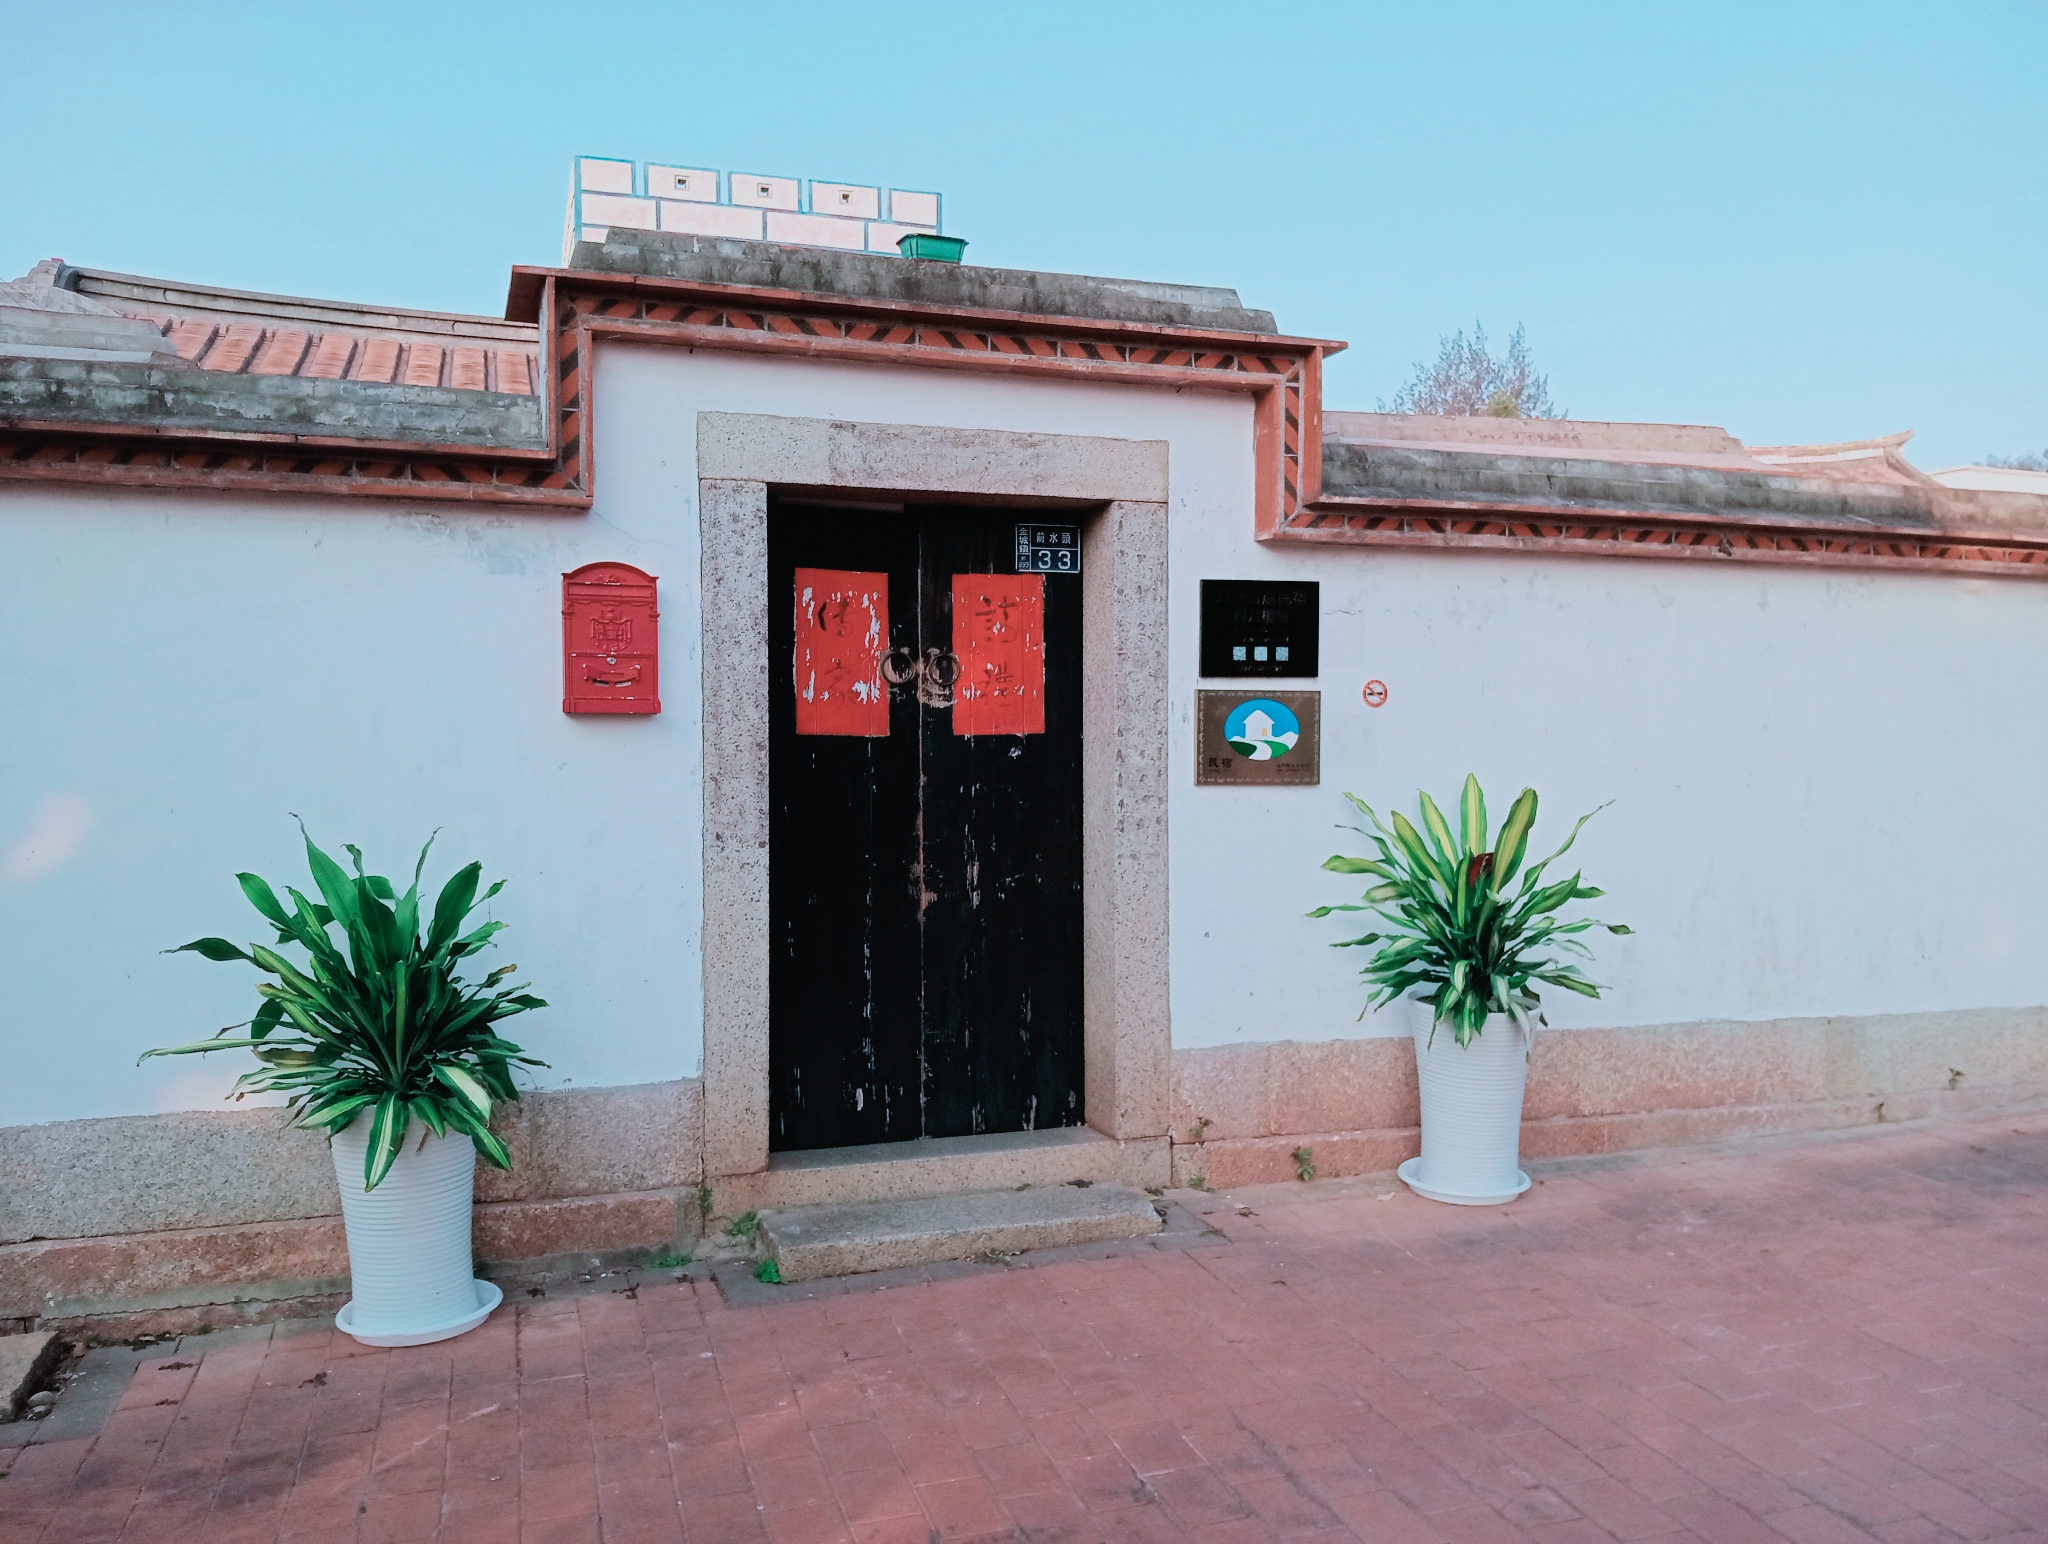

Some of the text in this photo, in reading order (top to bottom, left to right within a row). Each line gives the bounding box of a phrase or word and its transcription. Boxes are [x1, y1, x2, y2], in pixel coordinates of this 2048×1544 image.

[1018, 527, 1029, 553] 金城鎮
[1036, 531, 1071, 545] 前水頭
[1038, 550, 1071, 570] 33
[1208, 756, 1233, 768] 民宿
